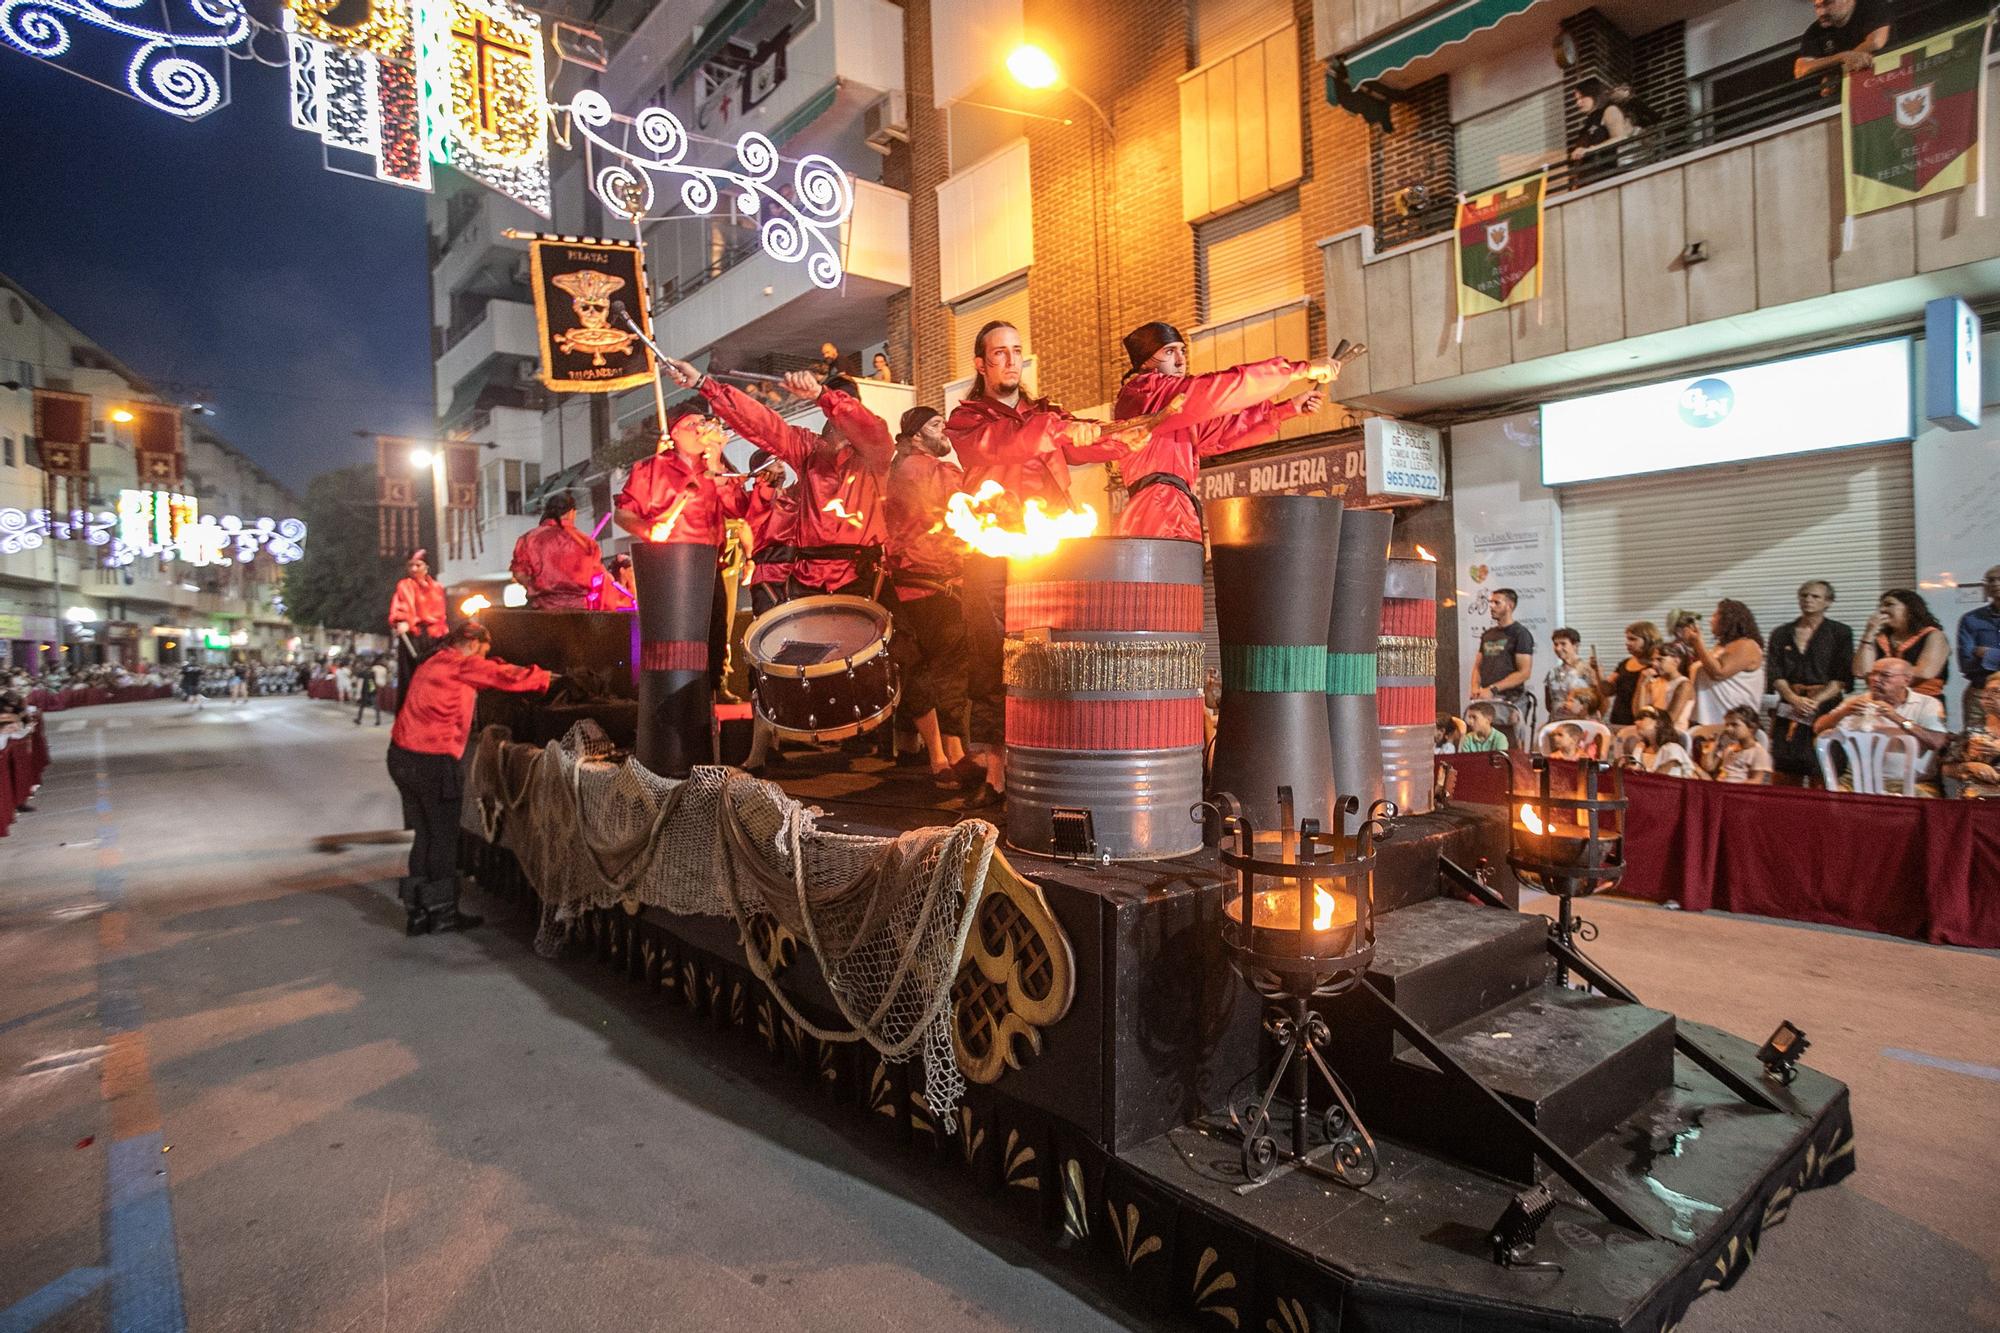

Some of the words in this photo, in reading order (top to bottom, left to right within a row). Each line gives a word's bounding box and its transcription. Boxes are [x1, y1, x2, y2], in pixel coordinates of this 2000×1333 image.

[1392, 436, 1402, 447] DE
[1404, 437, 1431, 450] POLLOS
[1391, 459, 1407, 468] PARA
[1205, 471, 1236, 499] PAN
[1250, 456, 1328, 494] BOLLERIA
[1386, 471, 1438, 490] 965305222
